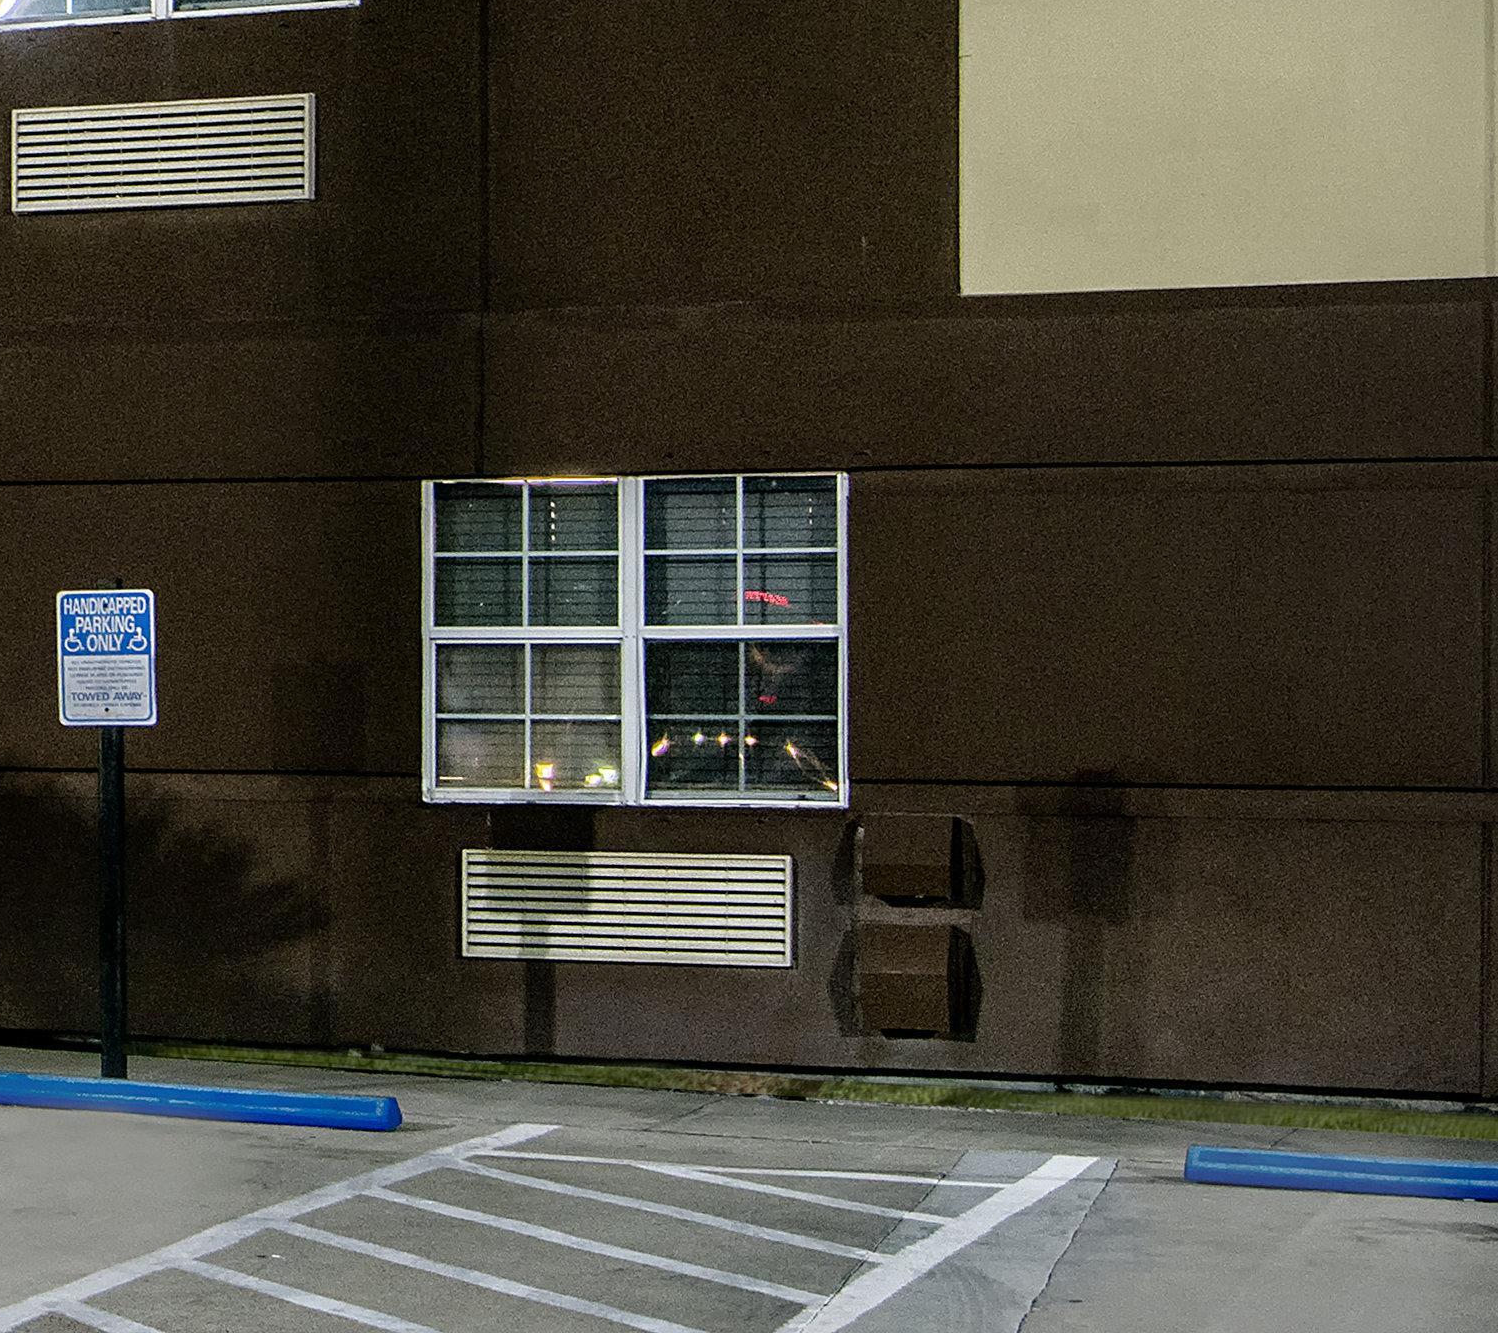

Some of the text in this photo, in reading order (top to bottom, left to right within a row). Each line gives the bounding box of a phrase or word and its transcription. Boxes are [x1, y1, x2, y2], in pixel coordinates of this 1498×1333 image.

[63, 596, 147, 615] HANDICAPPED
[75, 615, 136, 634] PARKING
[86, 634, 124, 652] ONLY
[71, 691, 144, 701] TOWED AWAY
